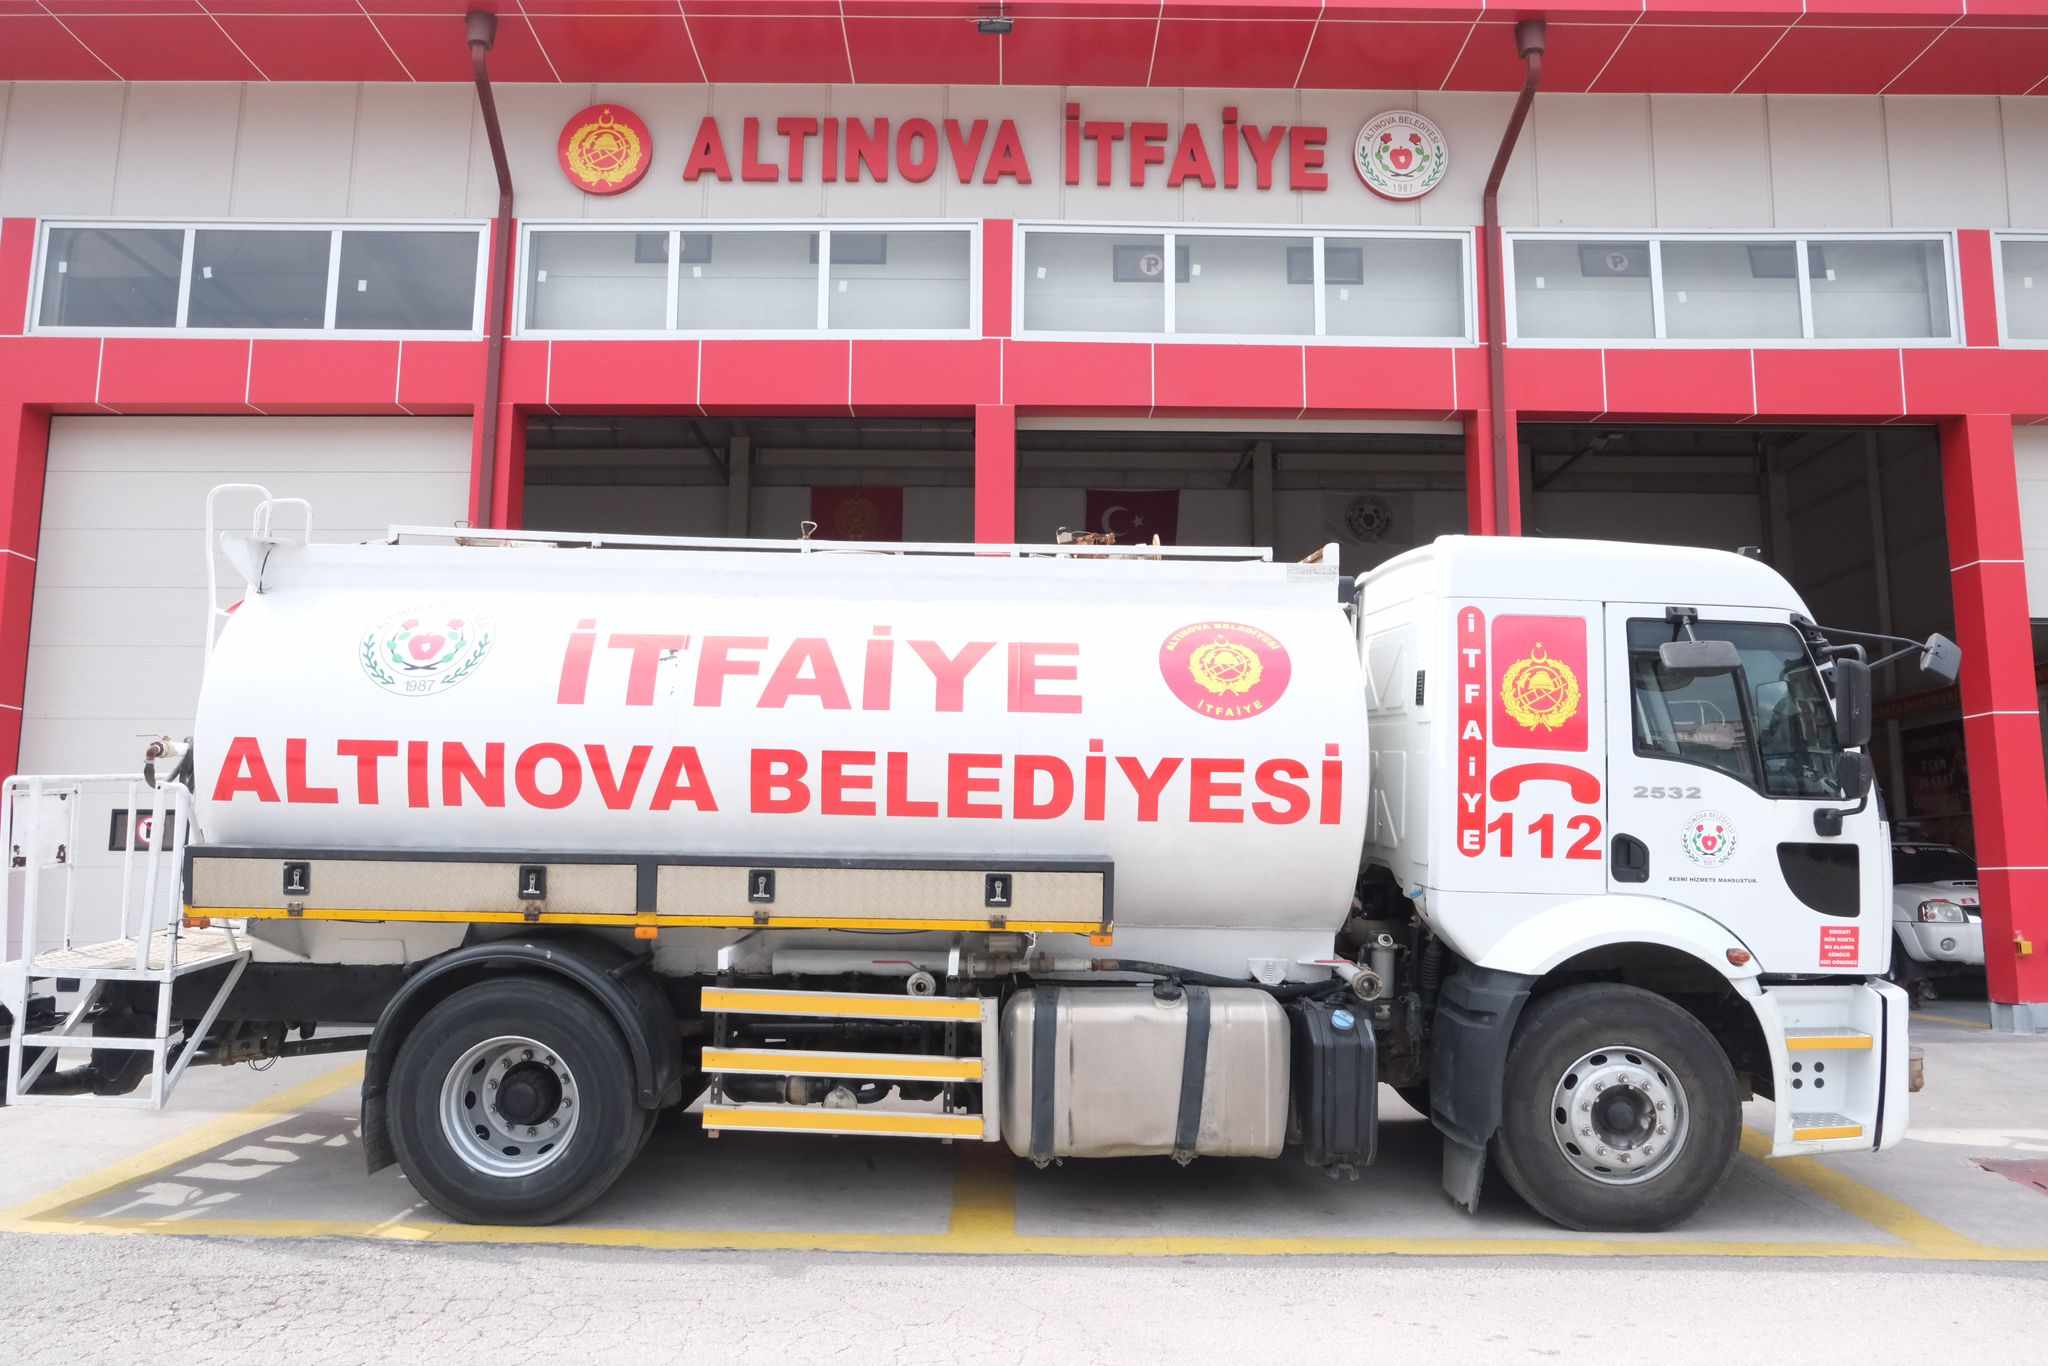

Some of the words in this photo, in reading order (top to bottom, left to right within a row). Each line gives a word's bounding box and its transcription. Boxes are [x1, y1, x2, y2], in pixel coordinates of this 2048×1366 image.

[683, 116, 1032, 184] ALTINOVA
[1065, 102, 1328, 191] İTFAİYE
[1364, 116, 1396, 142] ALTINOVA
[405, 679, 436, 692] 1987
[556, 618, 1083, 714] İTFAİYE
[211, 736, 719, 813] ALTINOVA
[750, 738, 1343, 825] BELEDİYESİ
[1633, 786, 1702, 799] 2532
[1487, 812, 1602, 860] 112
